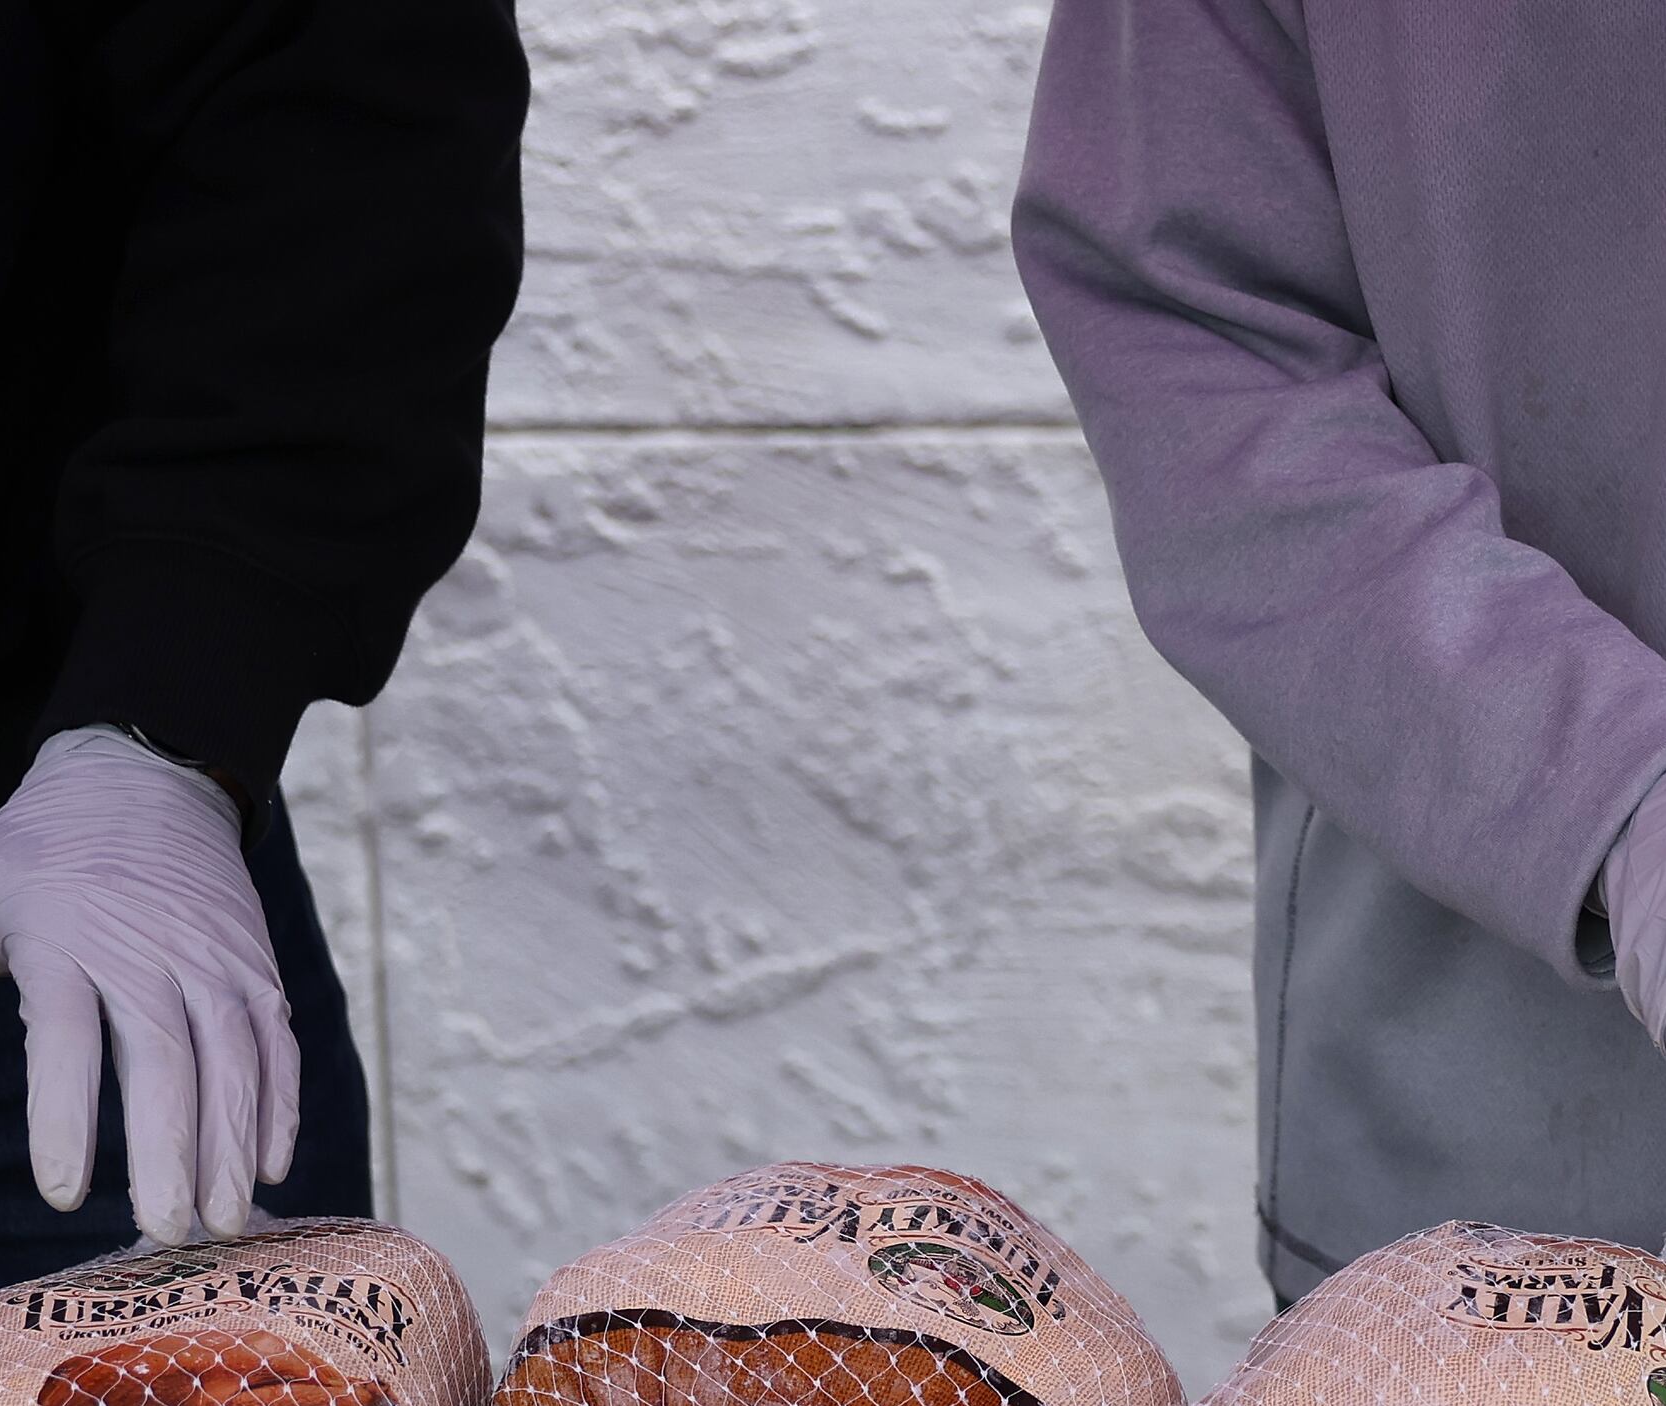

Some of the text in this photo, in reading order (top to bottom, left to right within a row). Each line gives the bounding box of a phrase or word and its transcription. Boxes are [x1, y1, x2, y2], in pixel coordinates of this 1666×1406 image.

[865, 1205, 1066, 1321] TURKEY
[1453, 1262, 1616, 1291] FARMS
[7, 1263, 414, 1341] TURKEY VALLEY
[268, 1295, 410, 1367] FARMS
[295, 1314, 342, 1339] SINCE
[1447, 1284, 1644, 1352] VALLEY
